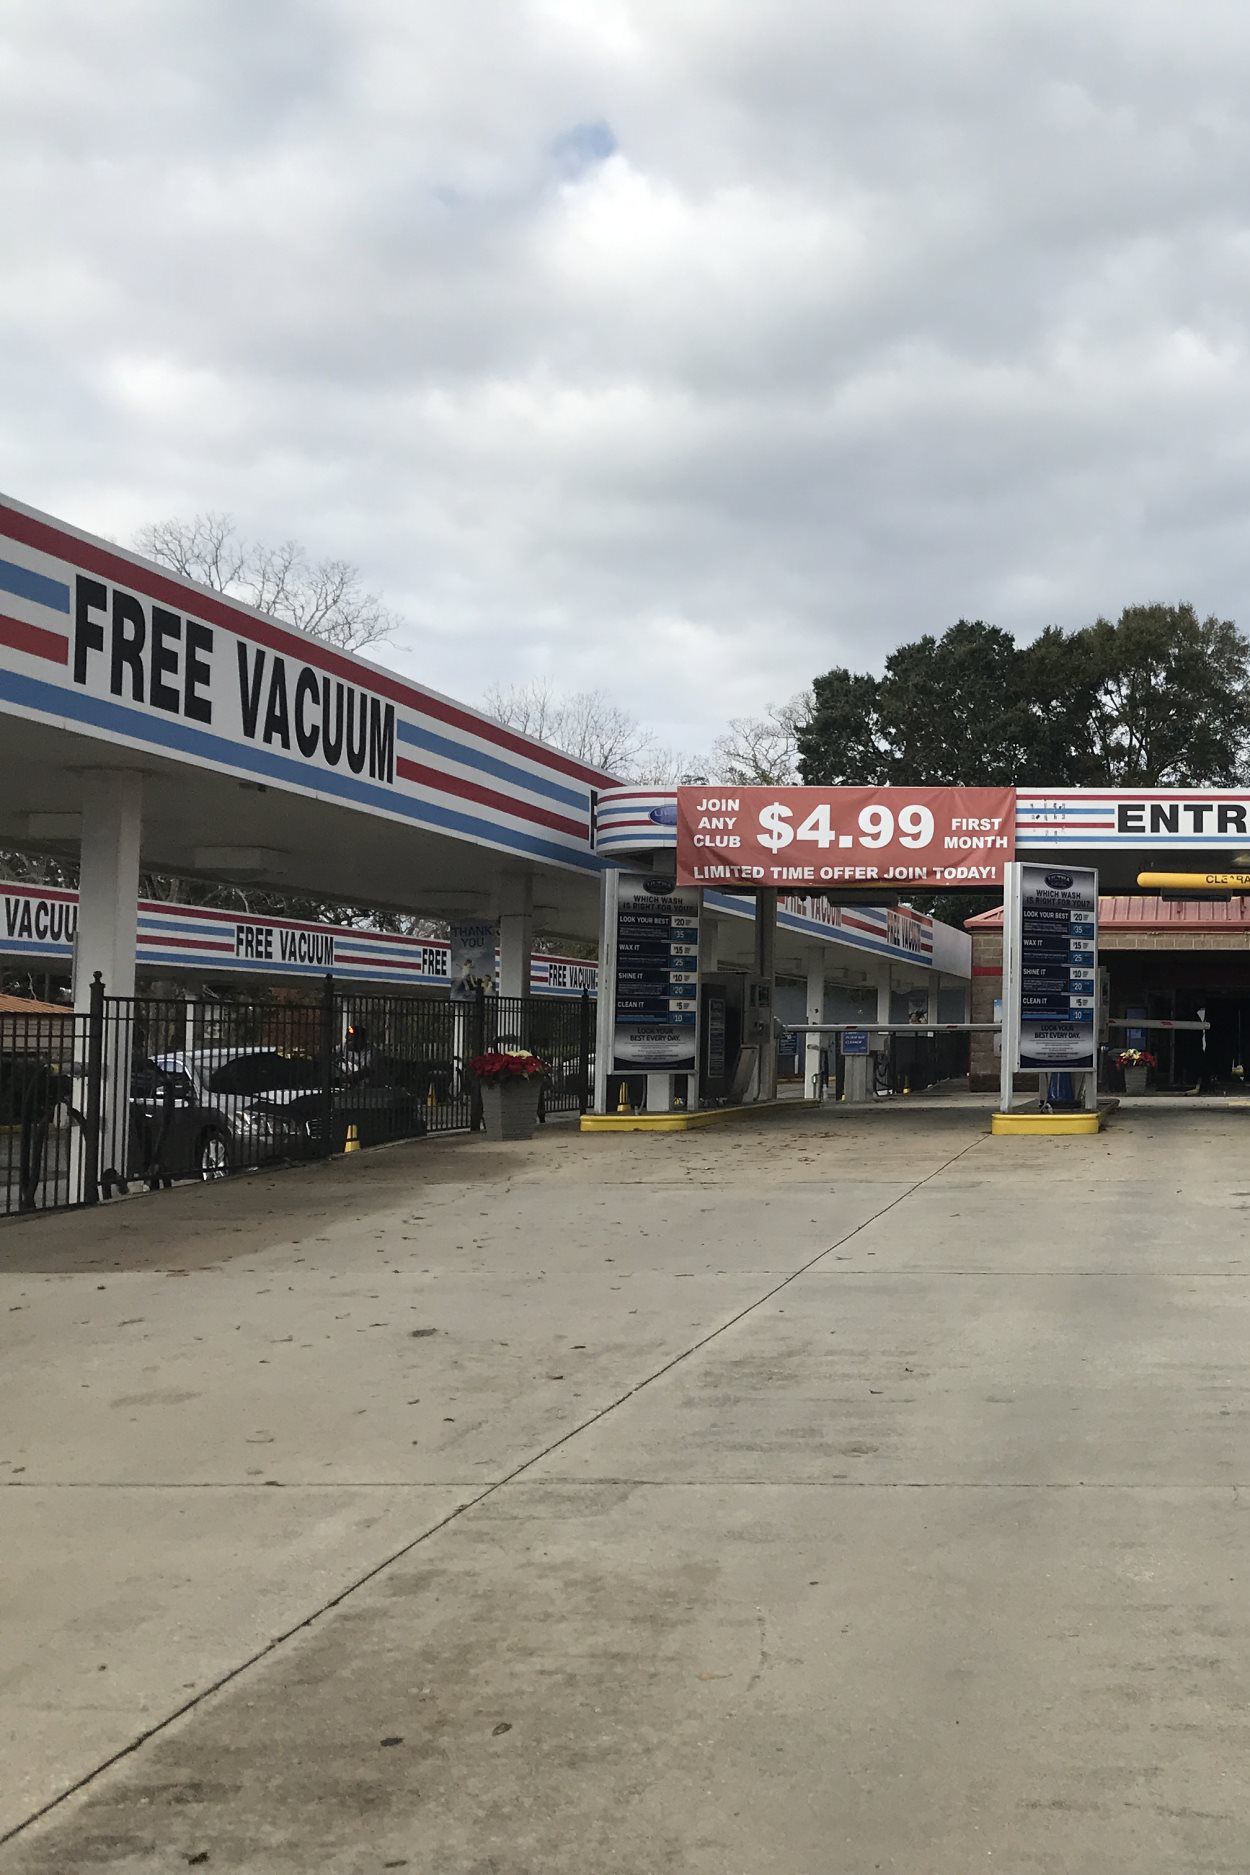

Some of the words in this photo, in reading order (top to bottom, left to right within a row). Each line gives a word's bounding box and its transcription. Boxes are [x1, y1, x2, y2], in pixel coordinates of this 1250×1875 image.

[73, 573, 214, 725] FREE
[236, 639, 395, 785] VACUUM
[696, 799, 740, 812] JOIN
[698, 817, 737, 830] ANY
[756, 802, 935, 854] $4.99
[951, 818, 1002, 831] FIRST
[693, 835, 741, 848] CLUB
[944, 836, 1008, 849] MONTH
[693, 865, 765, 879] LIMITED
[770, 866, 814, 880] TIME
[820, 866, 877, 880] OFFER
[883, 866, 927, 880] JOIN
[933, 866, 996, 880] TODAY!
[633, 895, 659, 903] WHICH
[661, 897, 683, 905] WASH
[1036, 889, 1059, 898] WHICH
[1061, 891, 1081, 899] WASH
[633, 903, 655, 911] RIGHT
[1035, 897, 1056, 905] RIGHT
[1058, 898, 1071, 906] FOR
[5, 897, 78, 942] VACUU
[452, 926, 492, 937] THANK
[235, 925, 273, 960] FREE
[279, 930, 334, 965] VACUUM
[461, 937, 485, 947] YOU
[422, 948, 447, 976] FREE
[549, 964, 567, 987] FREE
[569, 966, 596, 990] VACUUM
